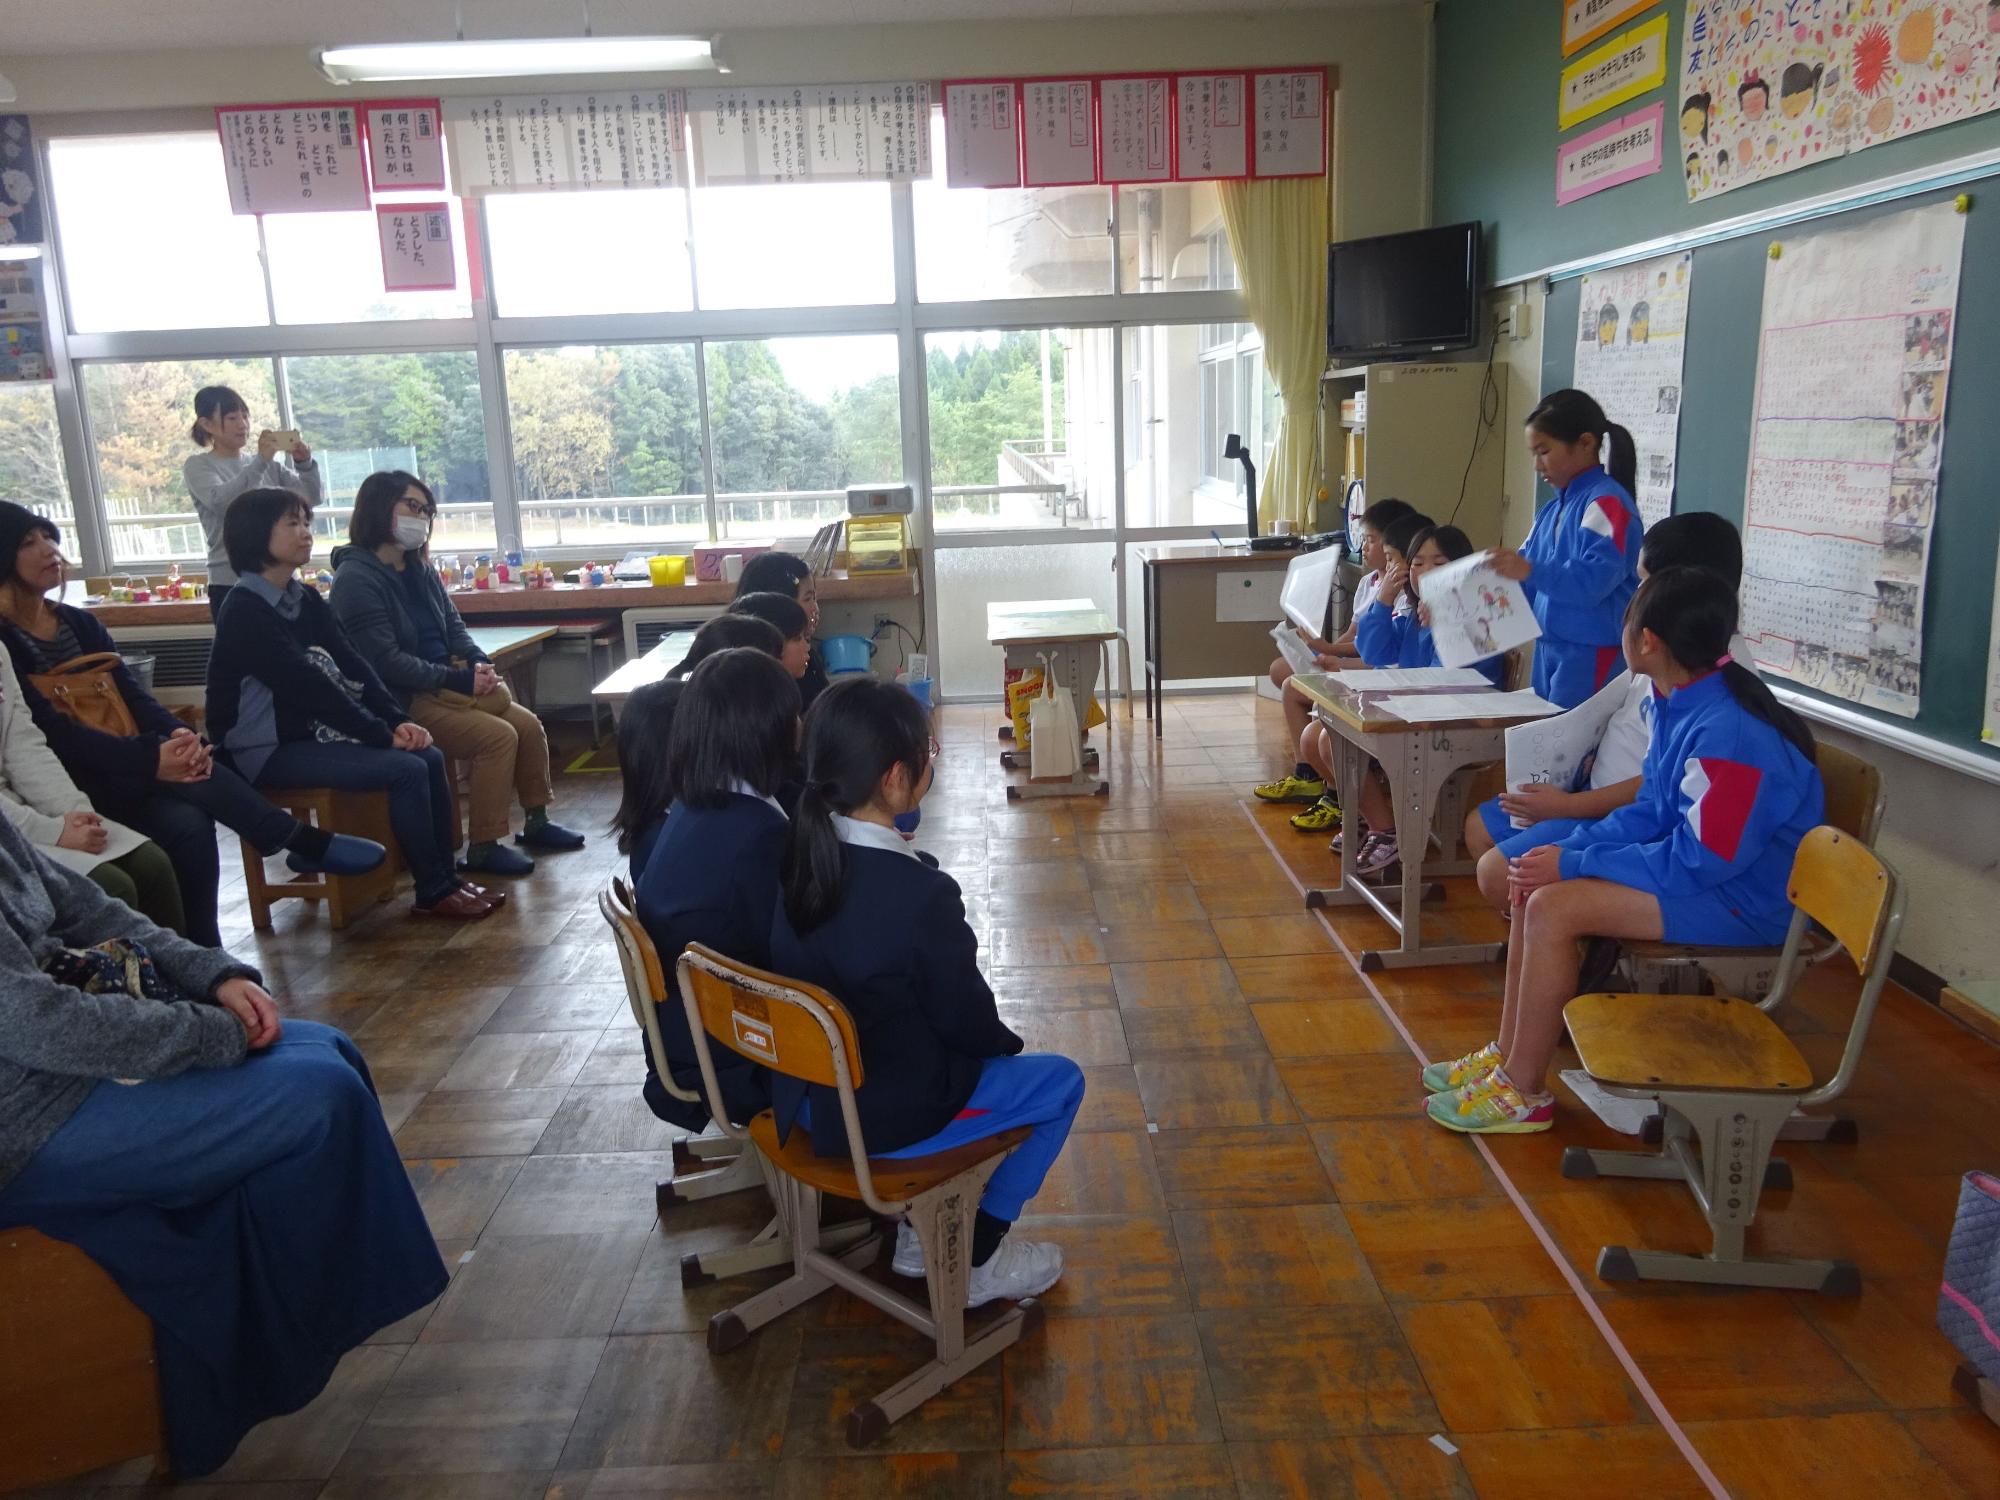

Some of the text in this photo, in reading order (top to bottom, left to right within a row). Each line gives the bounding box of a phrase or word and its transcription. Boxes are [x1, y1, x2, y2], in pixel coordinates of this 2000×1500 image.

[243, 114, 260, 168] どのように
[258, 113, 273, 167] どのくらい
[273, 113, 286, 145] どんな
[306, 112, 323, 177] いつ どこで
[321, 111, 338, 177] 何を だれに
[338, 110, 353, 146] 修飾語
[418, 113, 431, 136] 主語
[393, 217, 408, 256] なんだ。
[410, 216, 425, 267] どうした。
[429, 215, 442, 238] 述語
